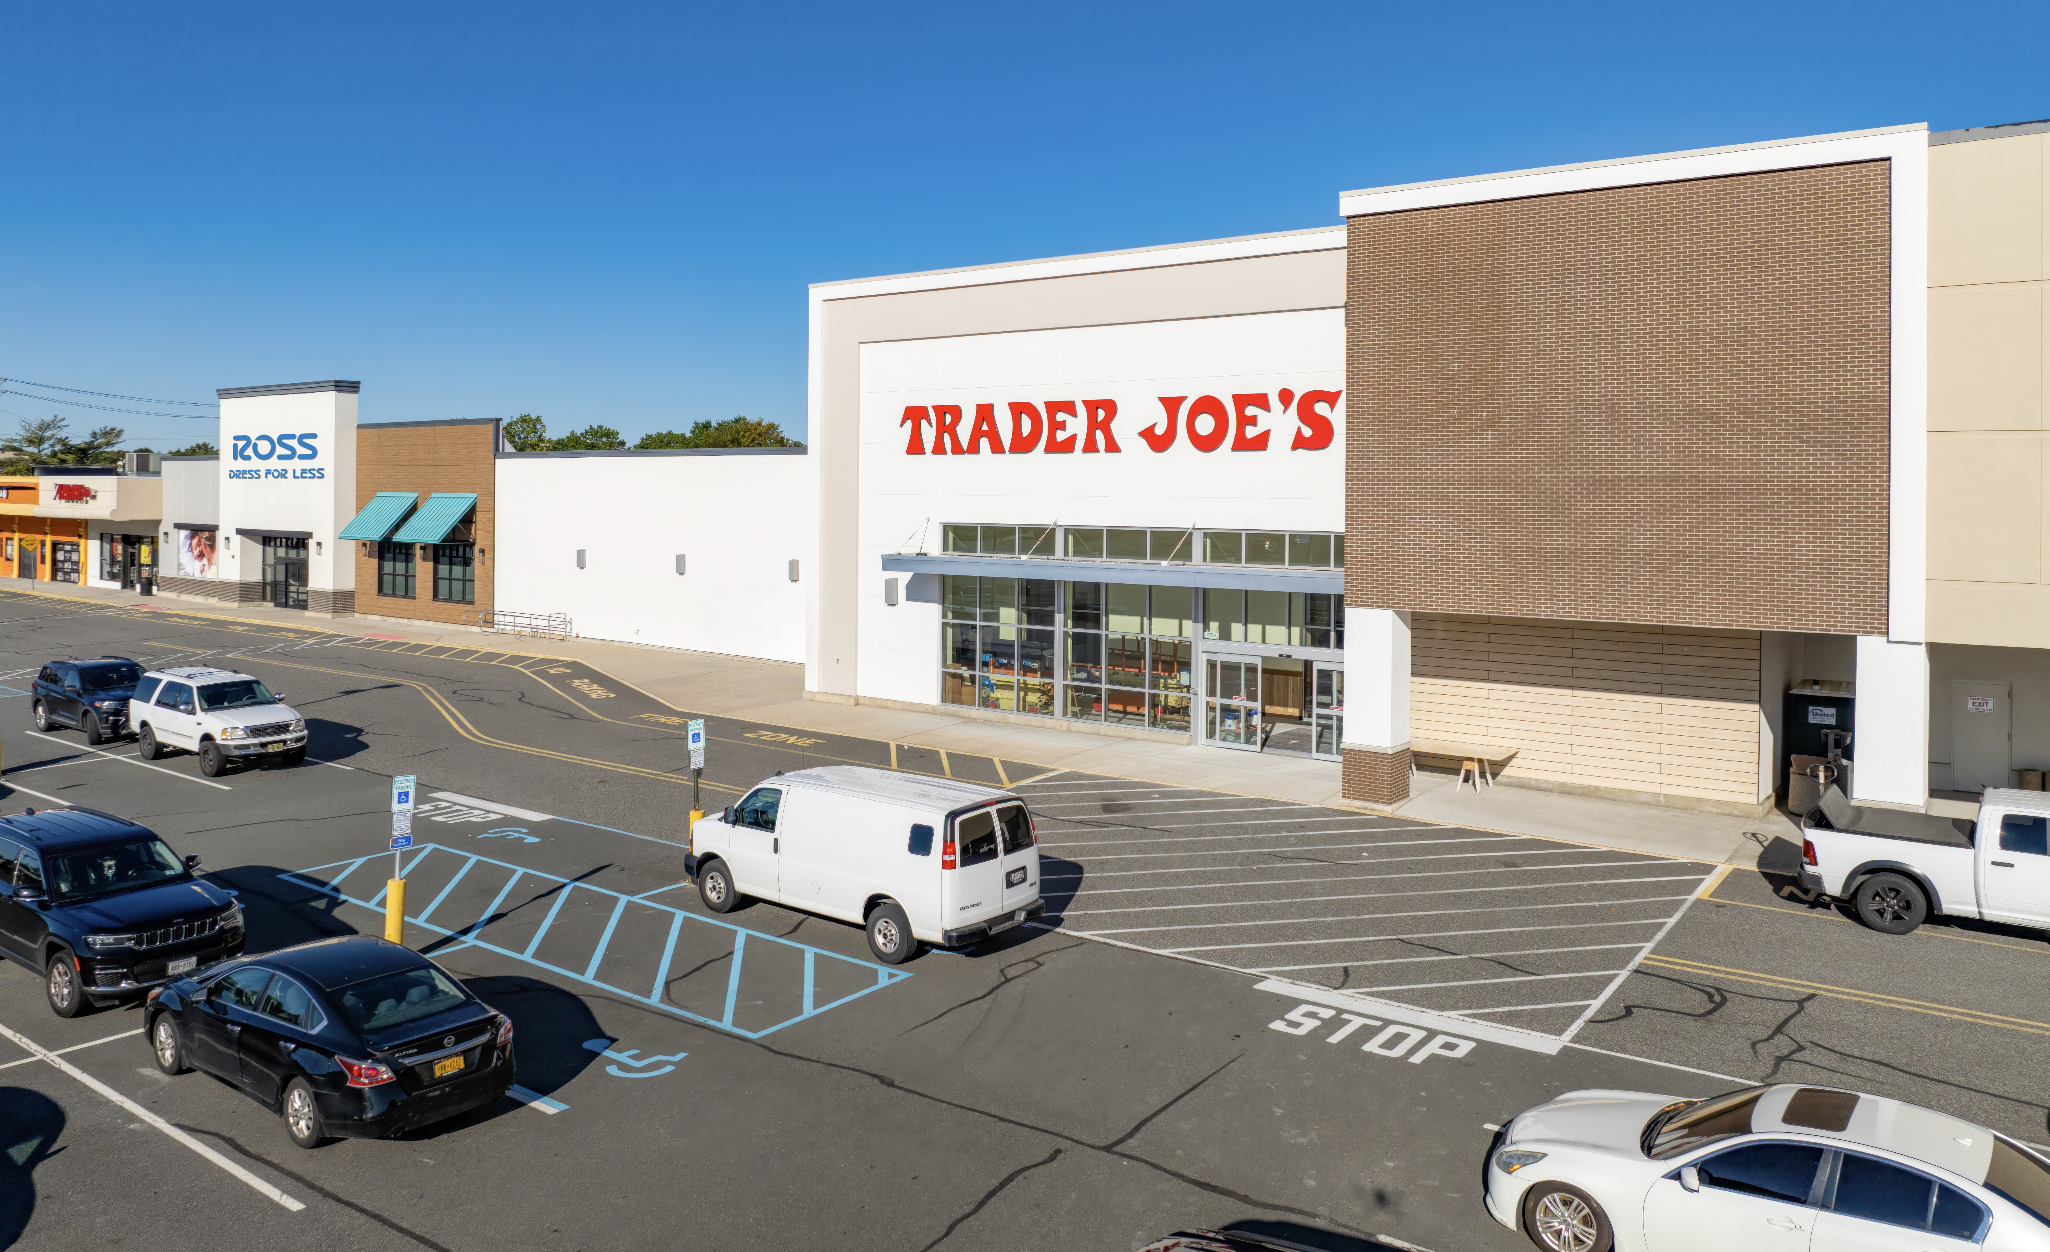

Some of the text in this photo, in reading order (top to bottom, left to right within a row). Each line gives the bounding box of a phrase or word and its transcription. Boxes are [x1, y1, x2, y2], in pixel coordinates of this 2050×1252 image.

[900, 387, 1343, 455] TRADER JOE'S
[232, 432, 318, 461] ROSS
[228, 467, 325, 480] DRESS FOR LESS
[1972, 700, 1990, 708] EXIT
[742, 730, 826, 747] ZONE
[411, 801, 505, 824] STOP
[1267, 1003, 1477, 1065] STOP
